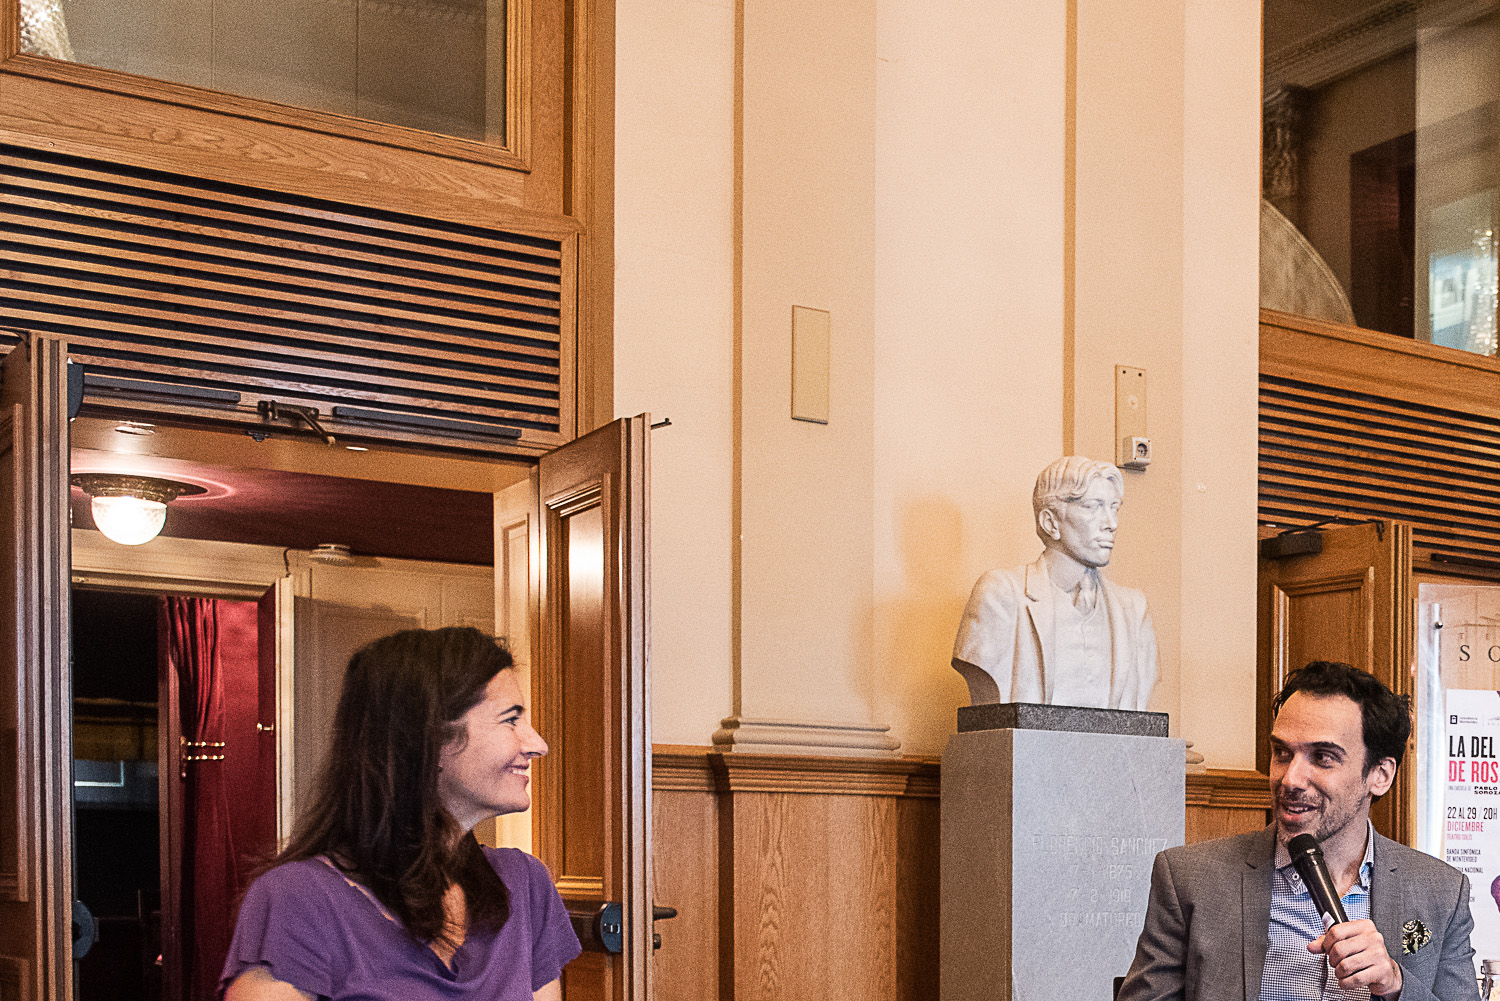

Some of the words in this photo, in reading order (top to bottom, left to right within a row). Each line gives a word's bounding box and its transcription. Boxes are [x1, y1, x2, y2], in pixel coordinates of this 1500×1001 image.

[1449, 735, 1466, 758] LA
[1471, 736, 1496, 759] DEL
[1448, 760, 1466, 782] DE
[1447, 806, 1457, 819] 22
[1458, 807, 1466, 819] AL
[1467, 807, 1477, 820] 29
[1483, 807, 1498, 820] 20H
[1447, 821, 1484, 832] DICIEMBRE
